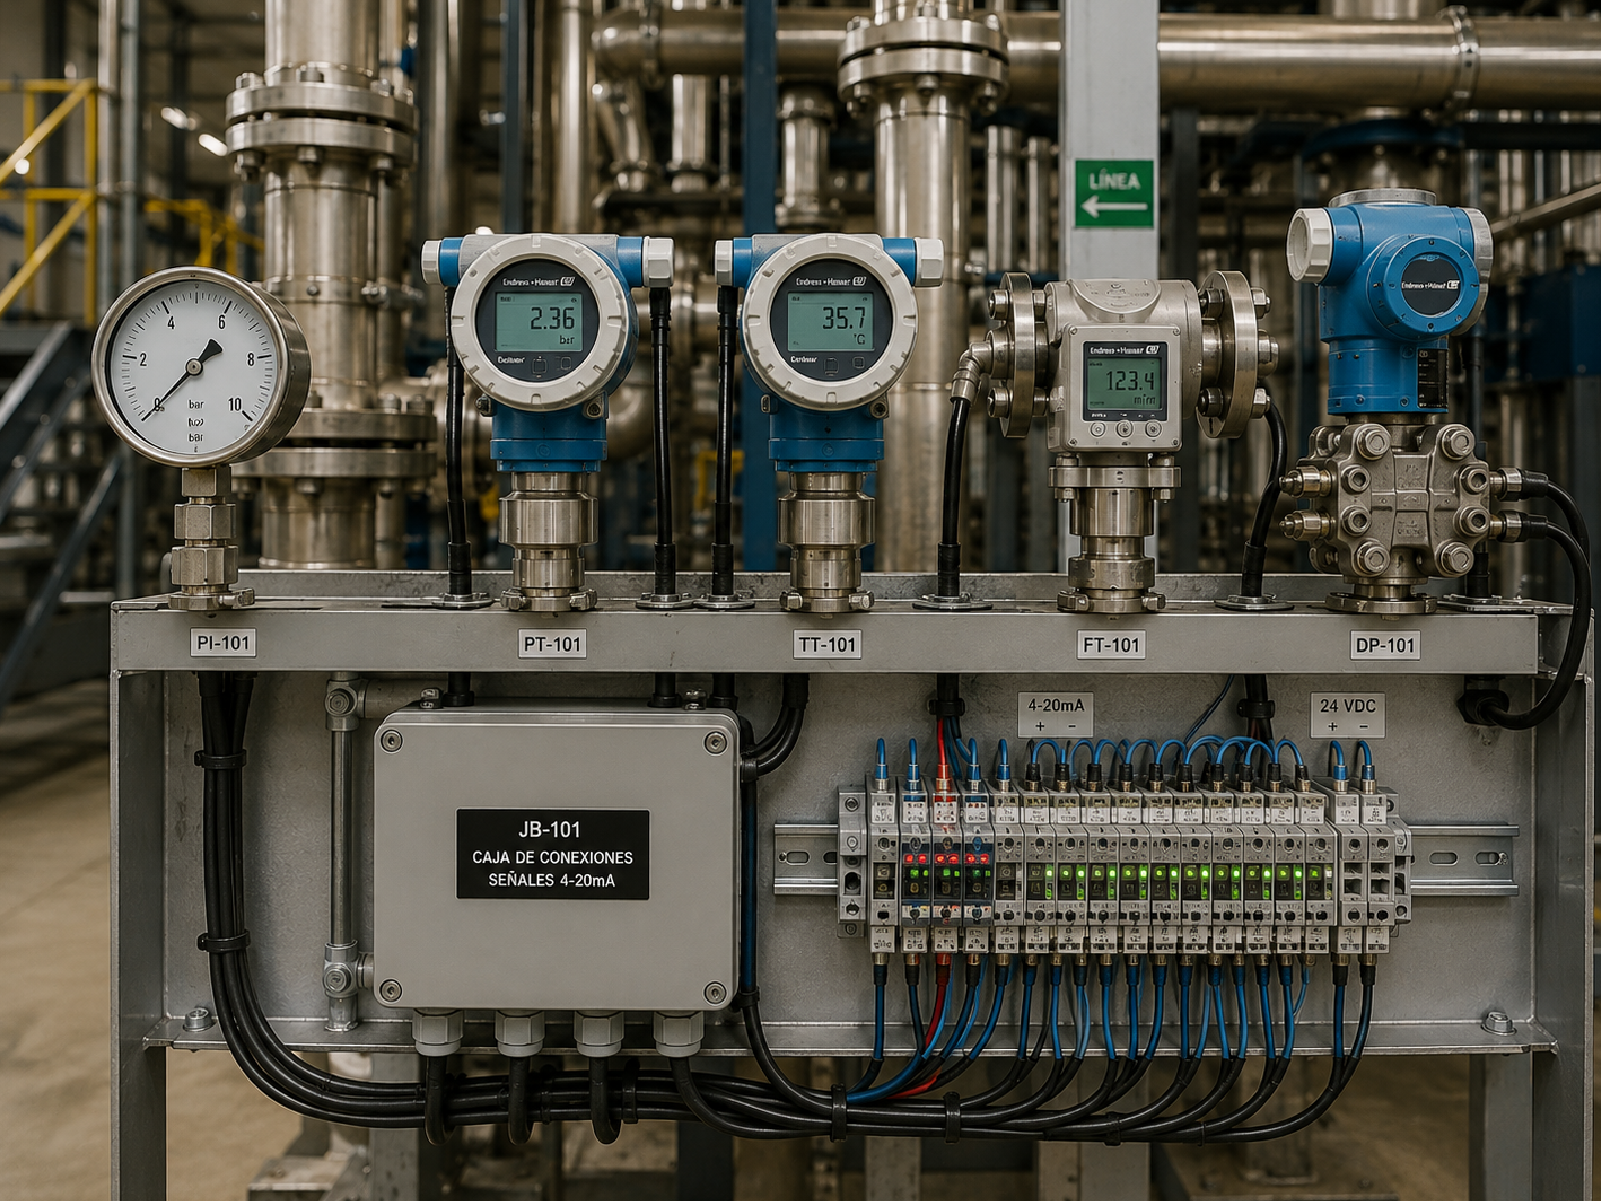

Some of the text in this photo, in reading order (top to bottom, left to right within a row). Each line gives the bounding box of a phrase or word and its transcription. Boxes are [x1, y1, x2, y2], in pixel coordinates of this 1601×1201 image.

[1089, 168, 1141, 190] LÍNEA
[167, 315, 175, 330] 4
[218, 314, 227, 330] 6
[530, 306, 575, 330] 2.36
[822, 306, 866, 330] 35.7
[139, 353, 147, 367] 2
[247, 353, 255, 367] 8
[1105, 370, 1155, 392] 123.4
[188, 399, 204, 410] bar
[228, 397, 242, 412] 10
[197, 635, 249, 650] PI-101
[524, 636, 580, 652] PT-101
[798, 637, 856, 653] TT-101
[1083, 637, 1139, 653] FT-101
[1356, 637, 1414, 653] DP-101
[1028, 698, 1085, 712] 4-20mA
[1320, 698, 1376, 713] 24 VDC
[518, 820, 581, 838] JB-101
[472, 850, 634, 865] CAJA DE CONEXIONES
[488, 870, 616, 888] SEÑALES 4-20mA
